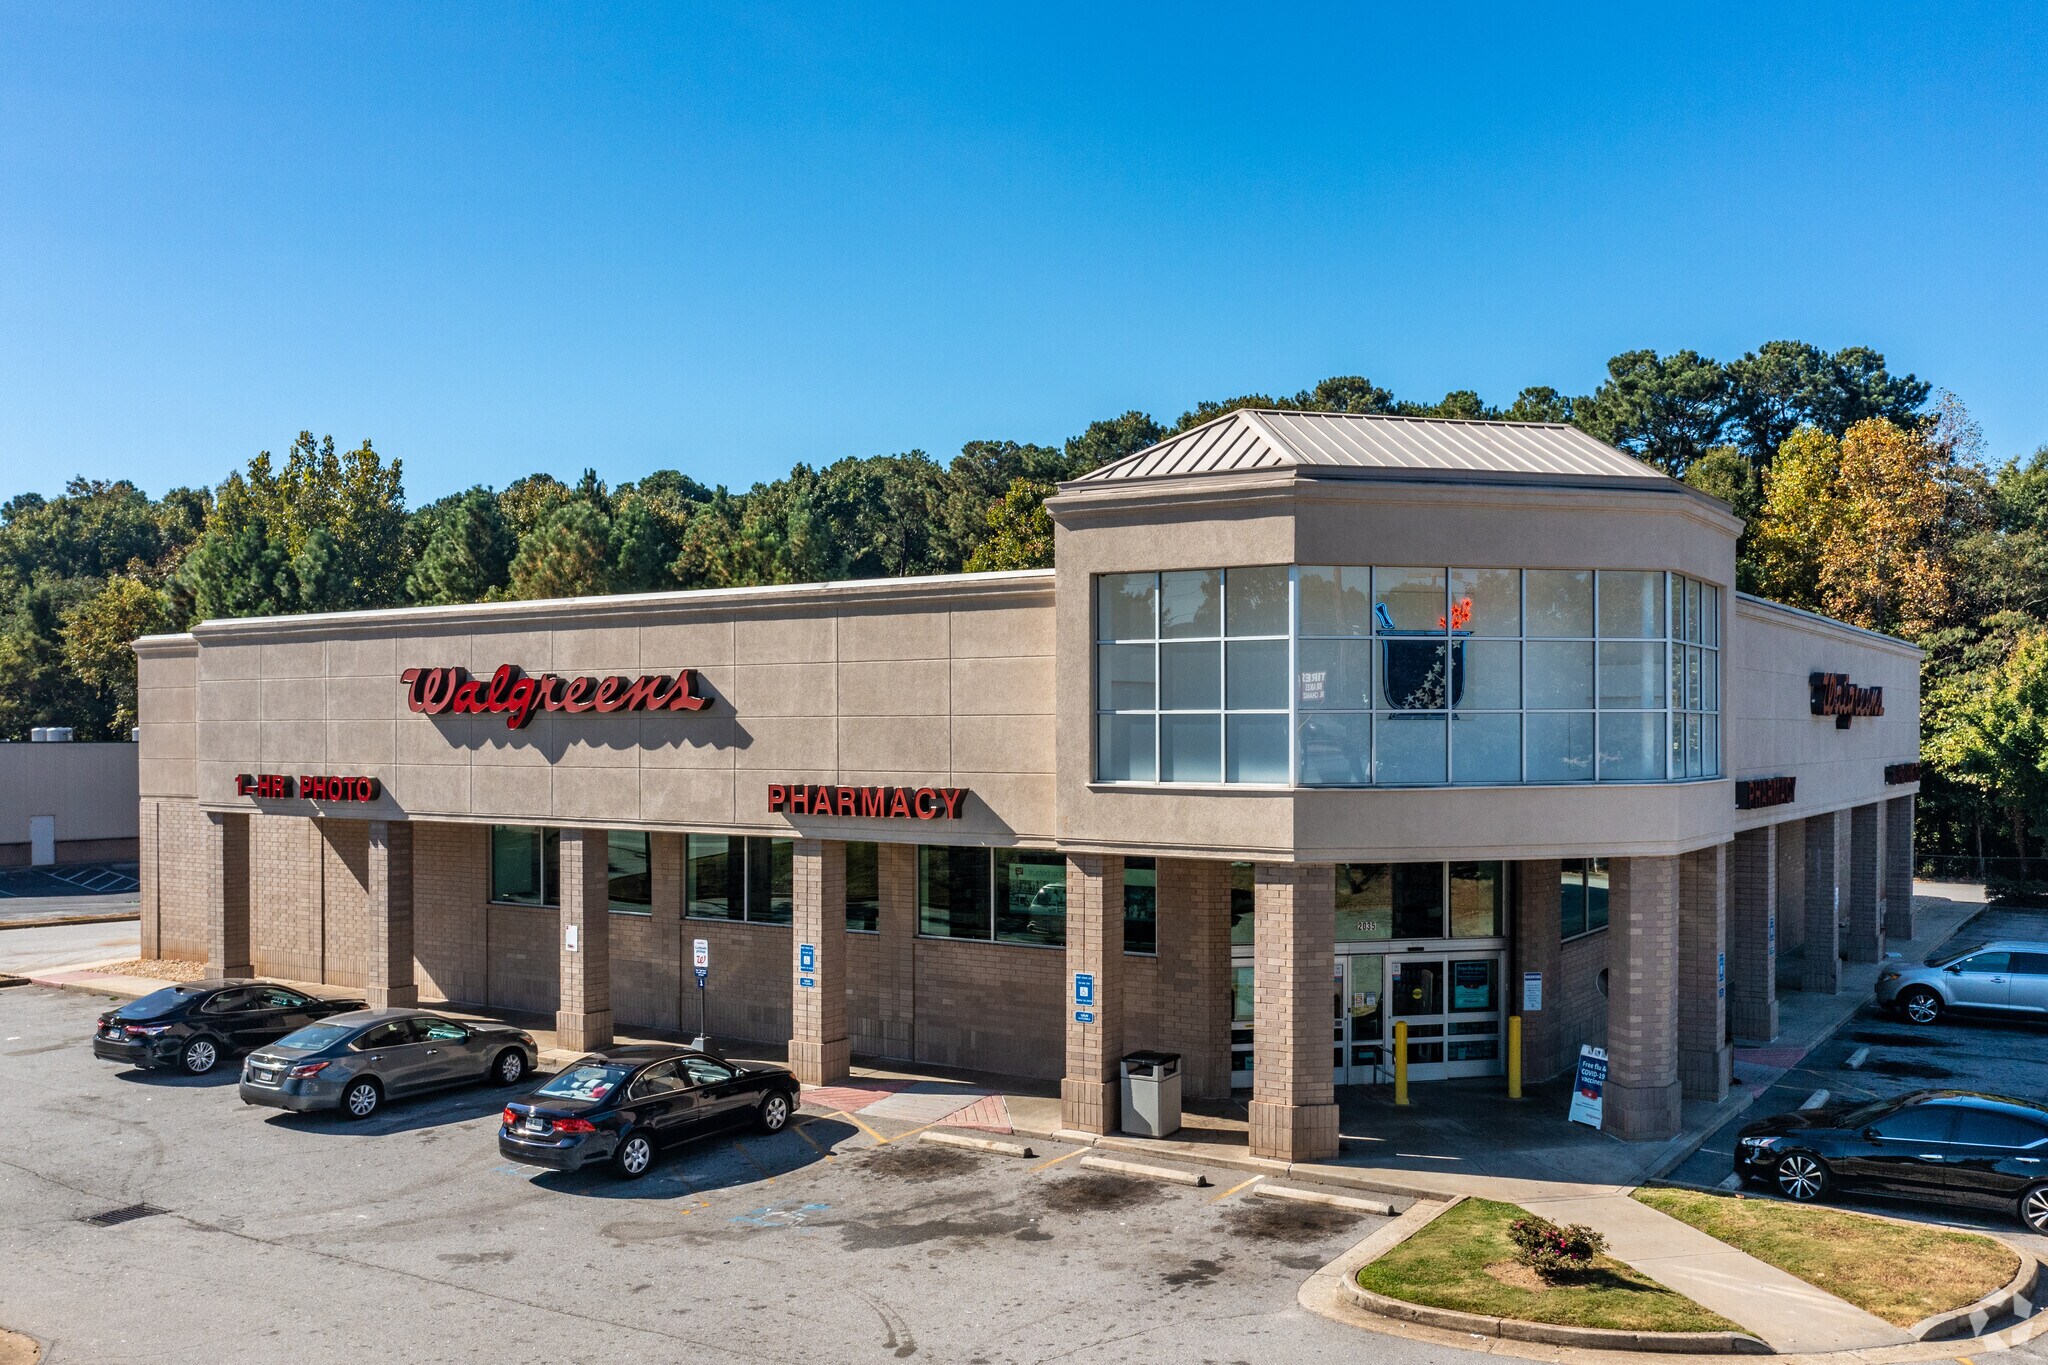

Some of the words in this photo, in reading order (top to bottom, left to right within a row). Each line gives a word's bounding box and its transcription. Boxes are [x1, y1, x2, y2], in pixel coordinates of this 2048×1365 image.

[400, 664, 708, 730] Walgreens
[235, 774, 287, 799] 1-HR
[300, 775, 374, 802] PHOTO
[768, 783, 967, 819] PHARMACY
[1357, 921, 1376, 931] 2035
[1581, 1068, 1606, 1080] COVID-19
[1582, 1061, 1594, 1069] Free
